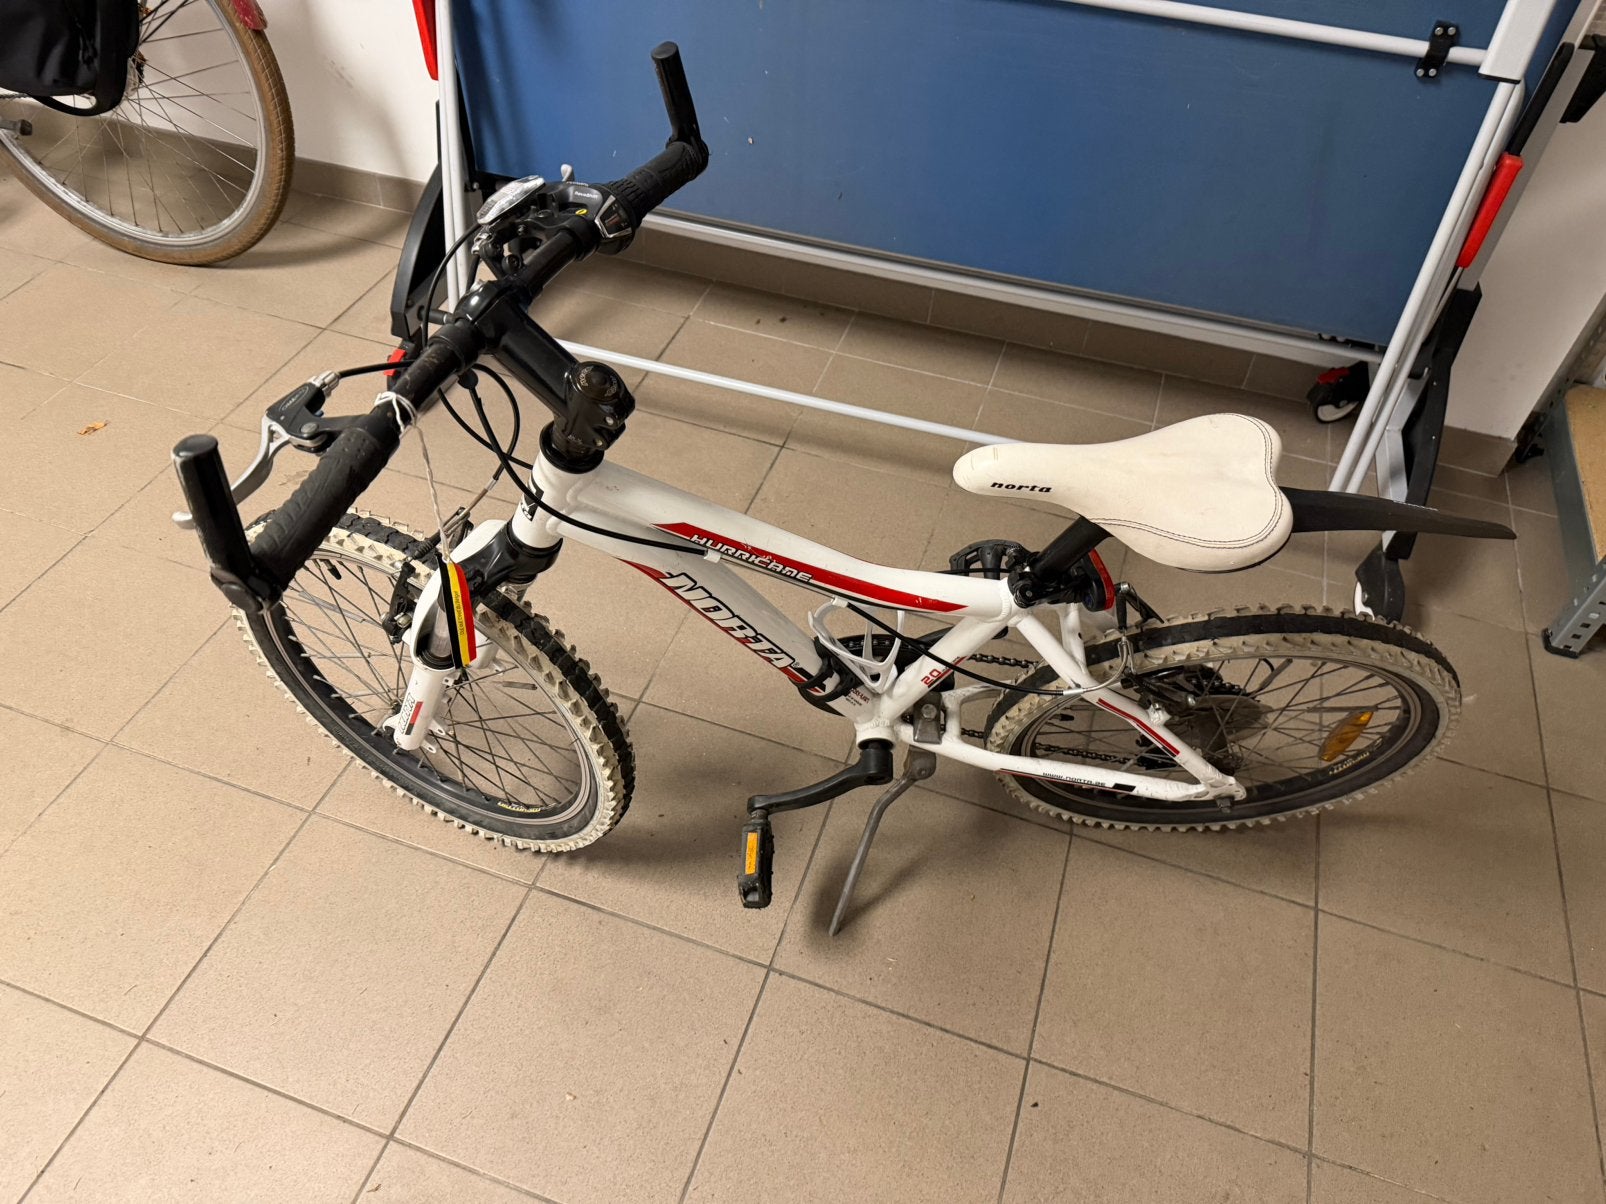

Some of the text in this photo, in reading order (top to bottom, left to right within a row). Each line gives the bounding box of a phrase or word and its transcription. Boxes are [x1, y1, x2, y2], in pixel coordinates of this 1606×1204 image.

[990, 481, 1053, 494] norta
[690, 534, 812, 583] HURRICANE
[659, 571, 797, 669] NORTA
[920, 668, 941, 687] 20
